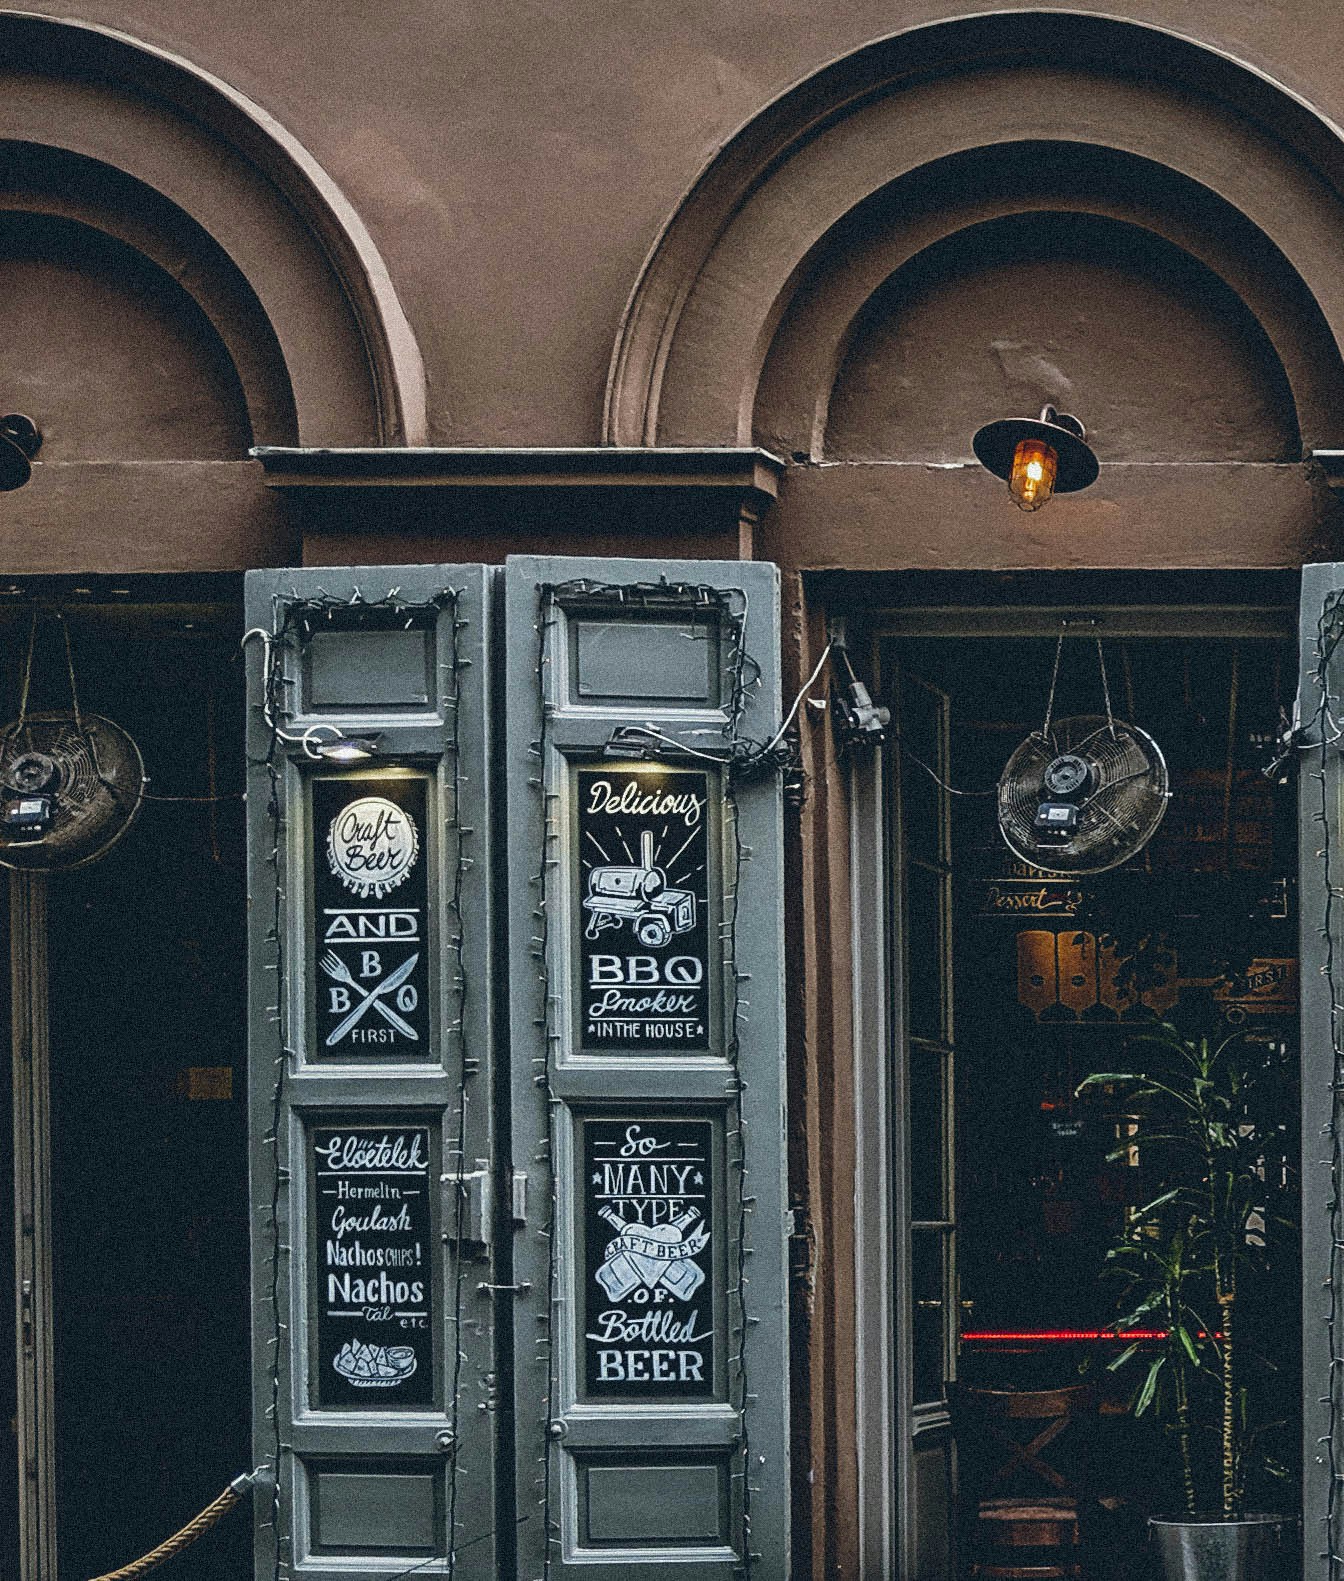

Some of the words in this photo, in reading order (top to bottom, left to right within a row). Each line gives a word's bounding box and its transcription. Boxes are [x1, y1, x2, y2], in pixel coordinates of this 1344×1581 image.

[587, 781, 706, 826] Delicious
[341, 813, 401, 851] Craft
[345, 845, 403, 871] Beer
[325, 914, 418, 937] AND
[589, 956, 702, 984] BBQ
[589, 990, 697, 1016] Smoker
[352, 1030, 395, 1043] FIRST
[597, 1023, 612, 1038] IN
[614, 1023, 641, 1038] THE
[646, 1023, 695, 1038] HOUSE
[620, 1125, 672, 1156] So
[338, 1181, 401, 1199] Hermelin
[604, 1165, 694, 1195] MANY
[331, 1204, 413, 1233] Goulash
[613, 1200, 684, 1225] TYPE
[327, 1240, 384, 1266] Nachos
[606, 1238, 653, 1256] CRAFT
[657, 1240, 701, 1258] BEER
[328, 1271, 423, 1303] Nachos
[586, 1309, 714, 1343] Bottled
[596, 1350, 704, 1381] BEER
